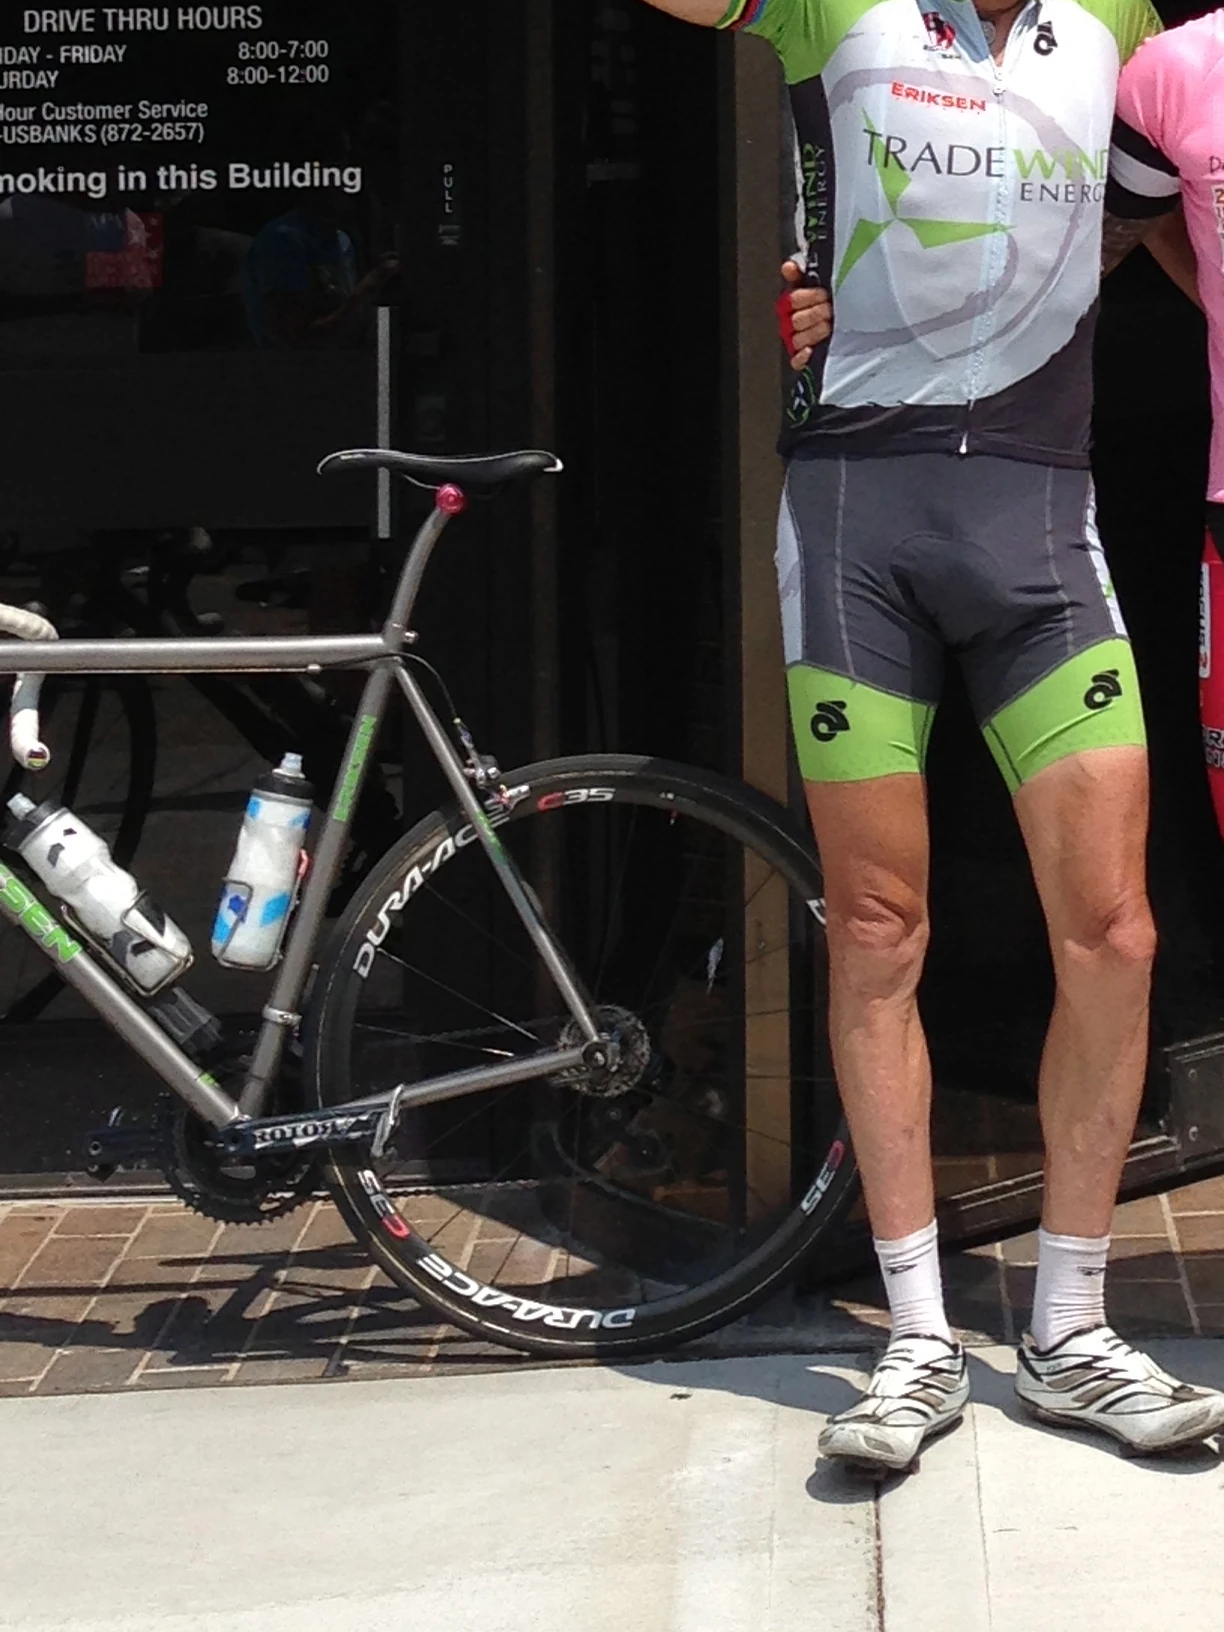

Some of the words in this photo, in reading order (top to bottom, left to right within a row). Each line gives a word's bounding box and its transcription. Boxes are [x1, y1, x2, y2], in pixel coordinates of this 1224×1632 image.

[23, 9, 95, 33] DRIVE
[103, 7, 169, 31] THRU
[177, 5, 262, 30] HOURS
[0, 46, 41, 65] DAY
[60, 44, 127, 64] FRIDAY
[238, 41, 329, 60] 8:00-7:00
[226, 66, 330, 85] 8:00-12:00
[890, 81, 987, 112] ERIKSEN
[42, 101, 133, 121] Customer
[138, 100, 208, 119] Service
[101, 122, 205, 146] (872-2657)
[118, 165, 147, 192] in
[157, 163, 217, 191] this
[228, 161, 362, 194] Building
[536, 787, 616, 812] C35
[416, 1253, 636, 1329] DURA-ACE
